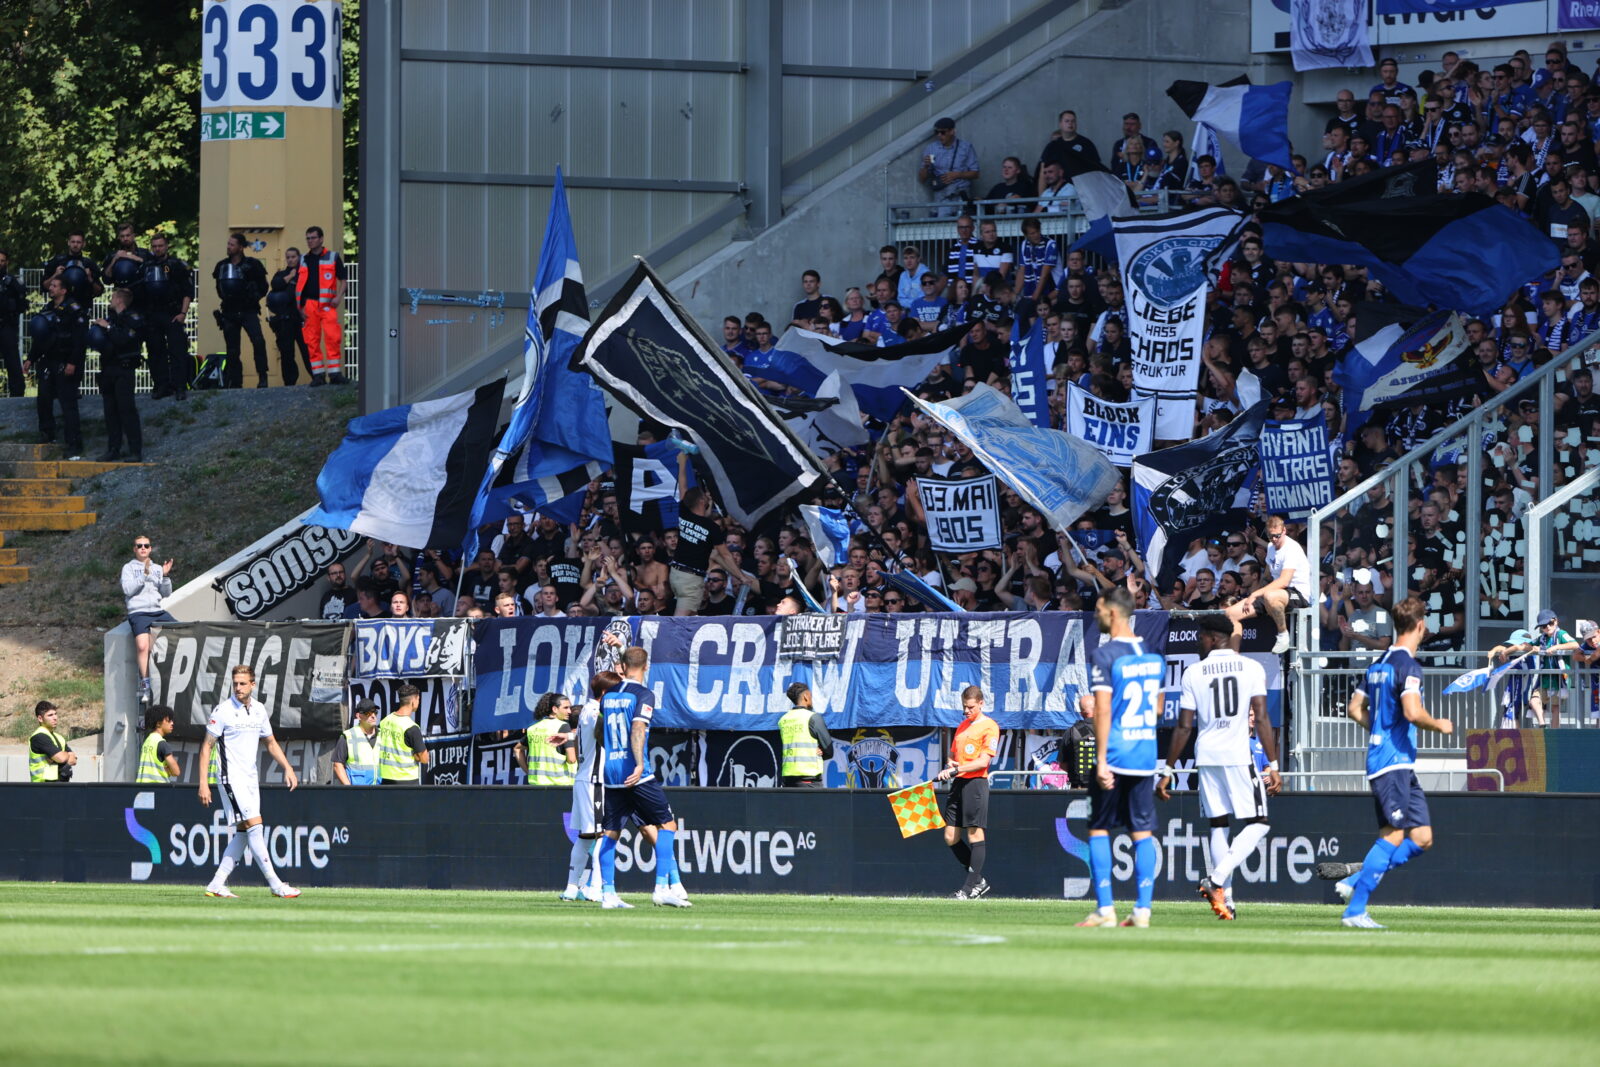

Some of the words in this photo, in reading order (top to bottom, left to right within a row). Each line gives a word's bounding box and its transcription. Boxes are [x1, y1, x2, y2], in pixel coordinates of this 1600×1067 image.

[238, 4, 278, 100] 3
[291, 4, 326, 101] 3
[1132, 290, 1197, 325] LIEBE
[1145, 323, 1177, 338] HASS
[1131, 331, 1194, 363] CHAOS
[1131, 362, 1186, 378] STRUKTUR
[1083, 396, 1140, 424] BLOCK
[1083, 416, 1140, 450] EINS
[1261, 425, 1326, 457] AVANTI
[1263, 454, 1329, 483] ULTRAS
[922, 483, 993, 512] 03.MAI
[1267, 480, 1332, 509] ARMINIA
[935, 515, 985, 544] 1905
[824, 615, 842, 631] ALS
[1168, 629, 1198, 643] BLOCK
[357, 624, 432, 675] BOYS
[149, 634, 312, 729] SPENGE
[493, 620, 664, 716] LOKL
[1202, 660, 1244, 676] BIELEFELD
[1121, 679, 1160, 728] 23
[1209, 676, 1239, 719] 10
[607, 712, 628, 749] 11
[332, 826, 350, 844] AG
[614, 817, 796, 876] sotware
[796, 831, 817, 850] AG
[1317, 837, 1340, 857] AG
